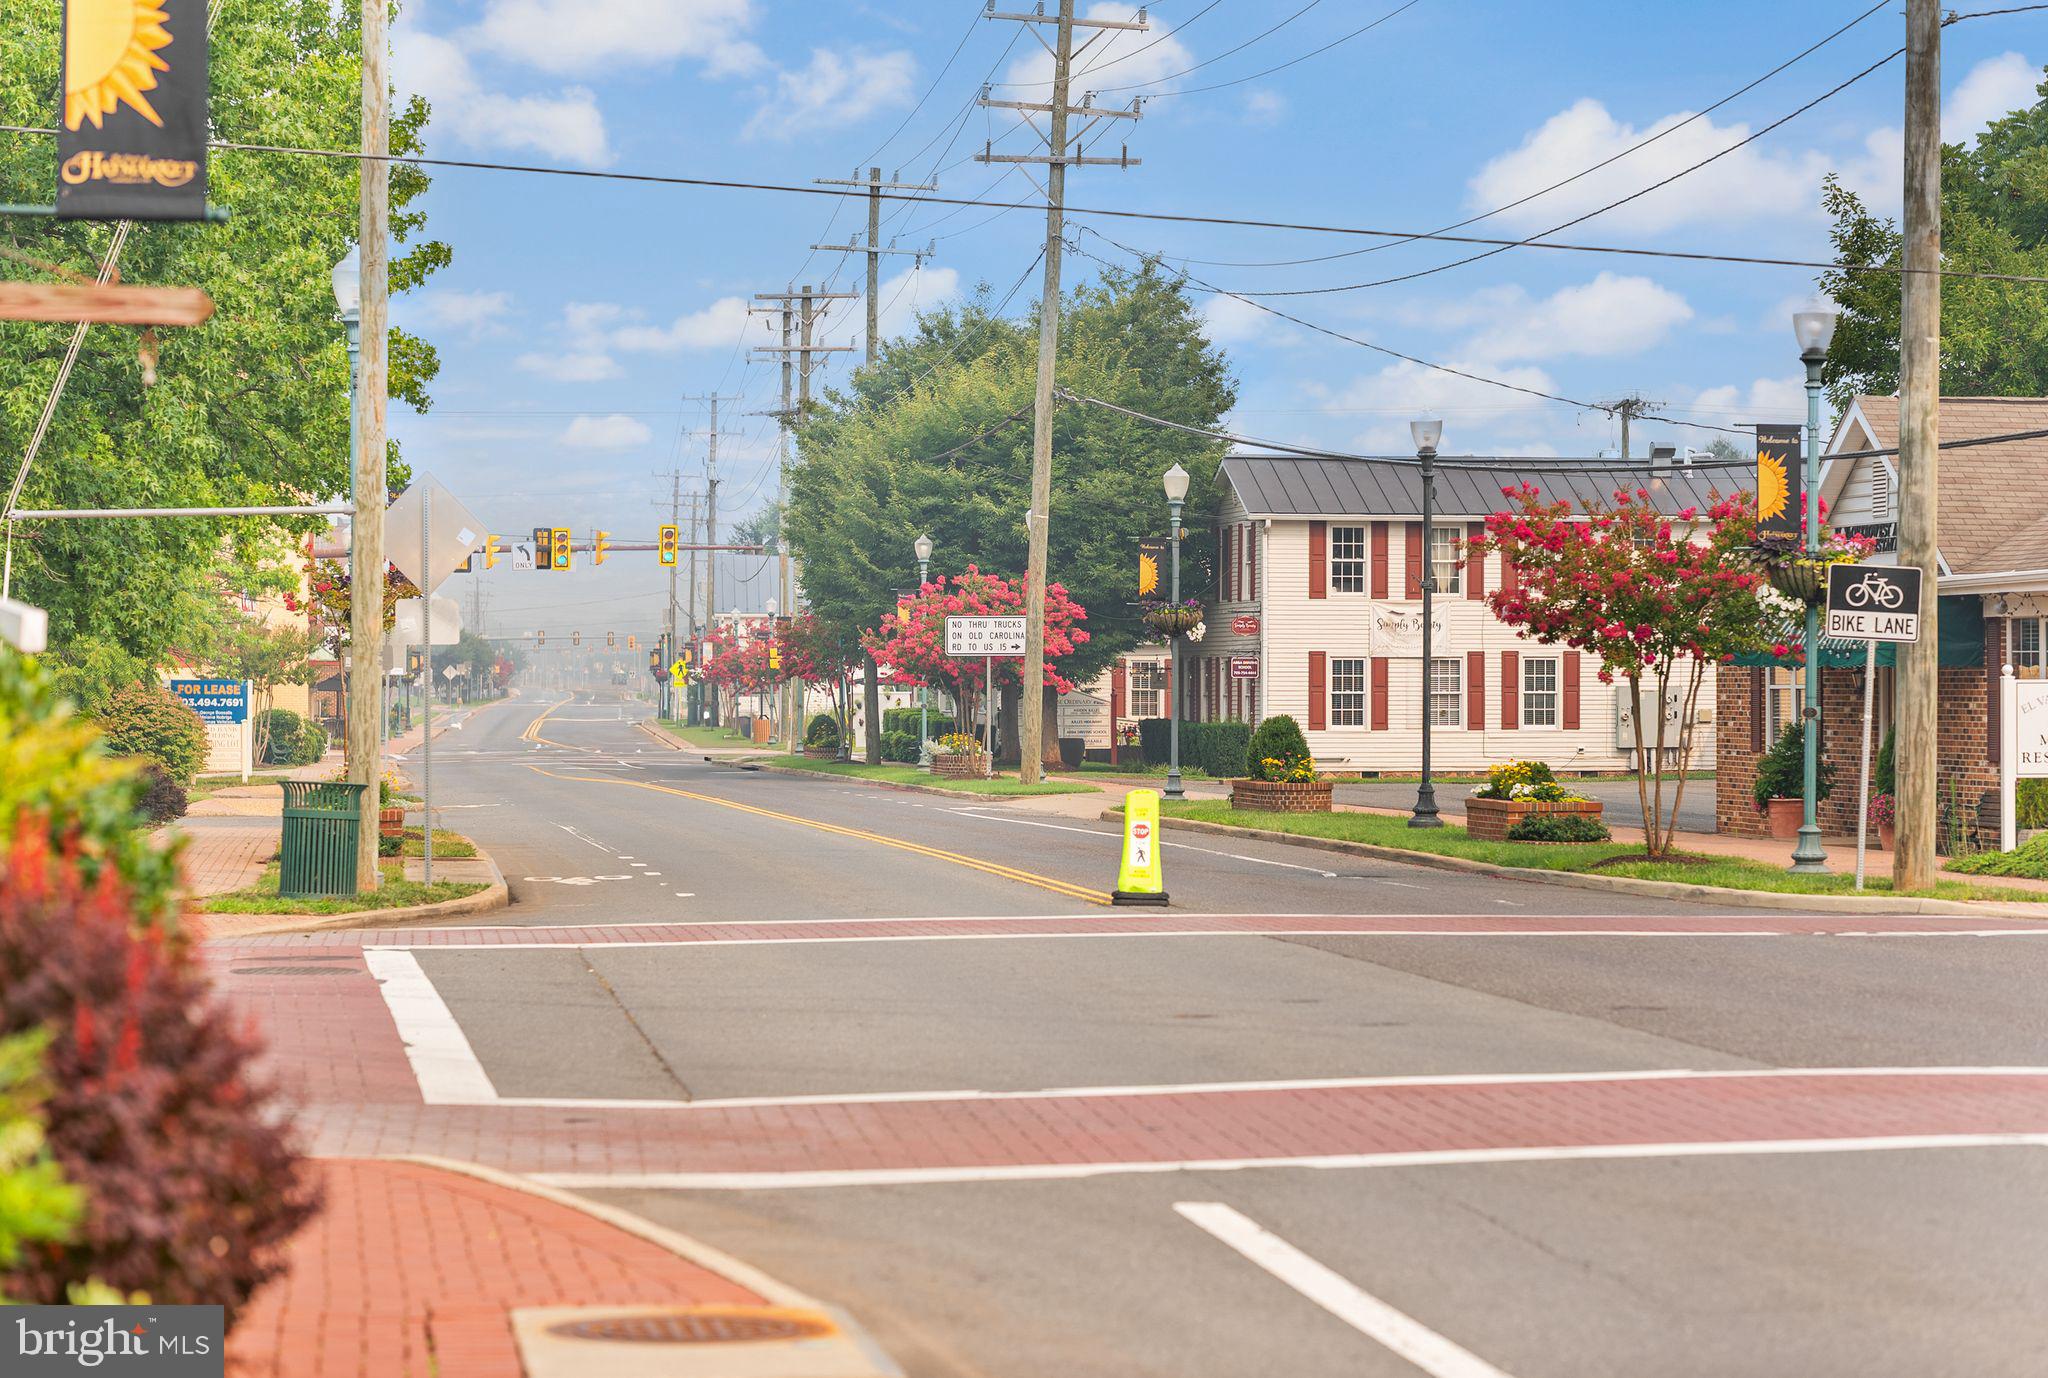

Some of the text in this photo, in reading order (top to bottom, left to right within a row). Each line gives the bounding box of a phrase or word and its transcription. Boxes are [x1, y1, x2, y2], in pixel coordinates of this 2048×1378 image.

[1758, 435, 1790, 444] Welcome
[952, 621, 1022, 629] NO THRU TRUCKS
[1832, 614, 1914, 635] BIKE LANE
[952, 643, 1007, 651] RD TO US 15
[177, 684, 241, 695] FOR LEASE
[181, 698, 244, 707] 03.494.7691
[1133, 827, 1149, 835] STOP
